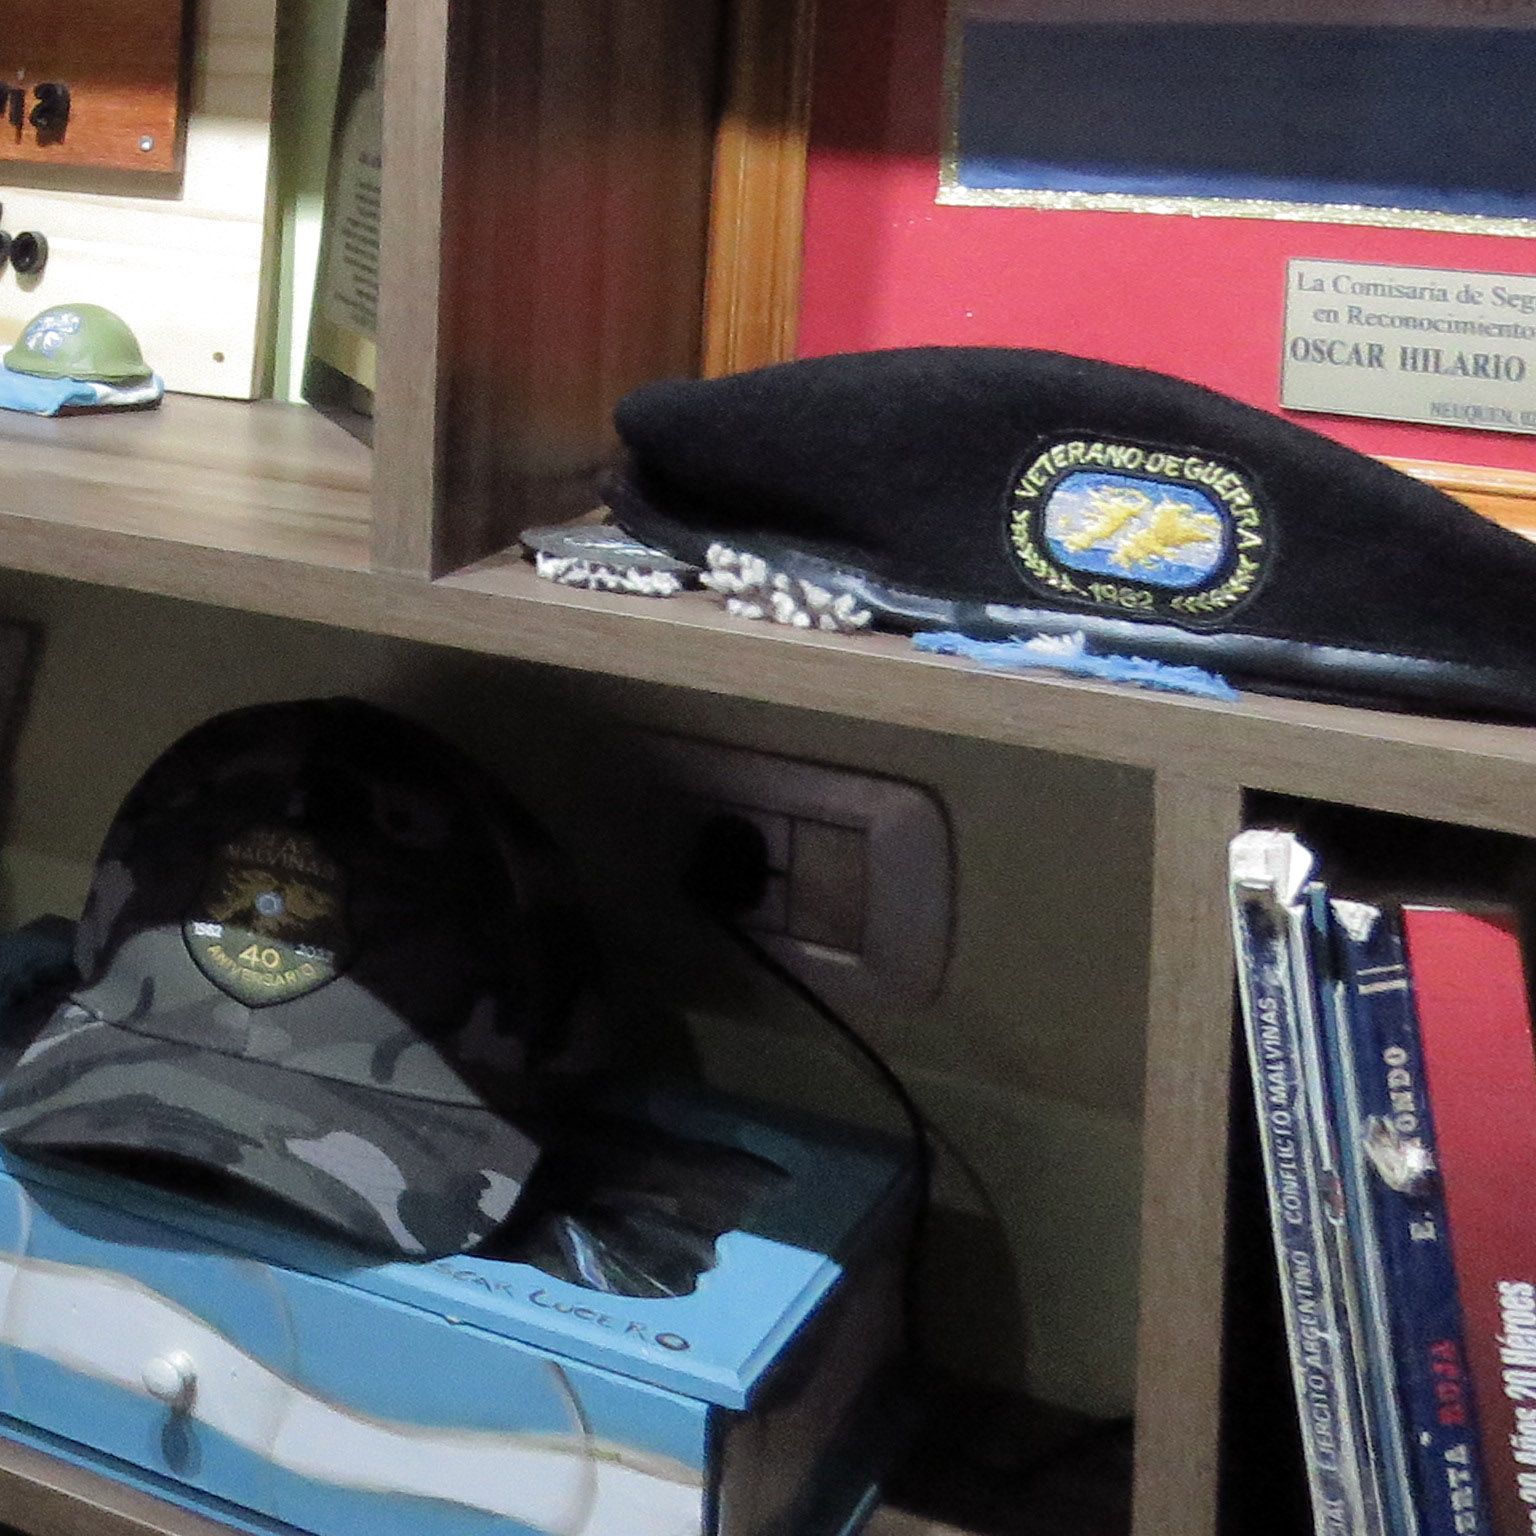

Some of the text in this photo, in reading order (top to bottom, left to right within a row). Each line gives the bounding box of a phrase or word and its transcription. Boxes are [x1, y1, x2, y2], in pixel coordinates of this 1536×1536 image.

[1296, 272, 1326, 292] La
[1454, 283, 1484, 306] de
[1313, 304, 1536, 341] en Reconocimiento
[1289, 337, 1385, 370] OSCAR
[1014, 440, 1144, 499] VETERANO
[1144, 451, 1184, 478] DE
[238, 944, 282, 969] 40
[1257, 996, 1288, 1104] MALVINAS
[1271, 1112, 1304, 1226] CONFLICTO
[528, 1288, 691, 1352] LUCERO
[1494, 1279, 1536, 1365] Héroes
